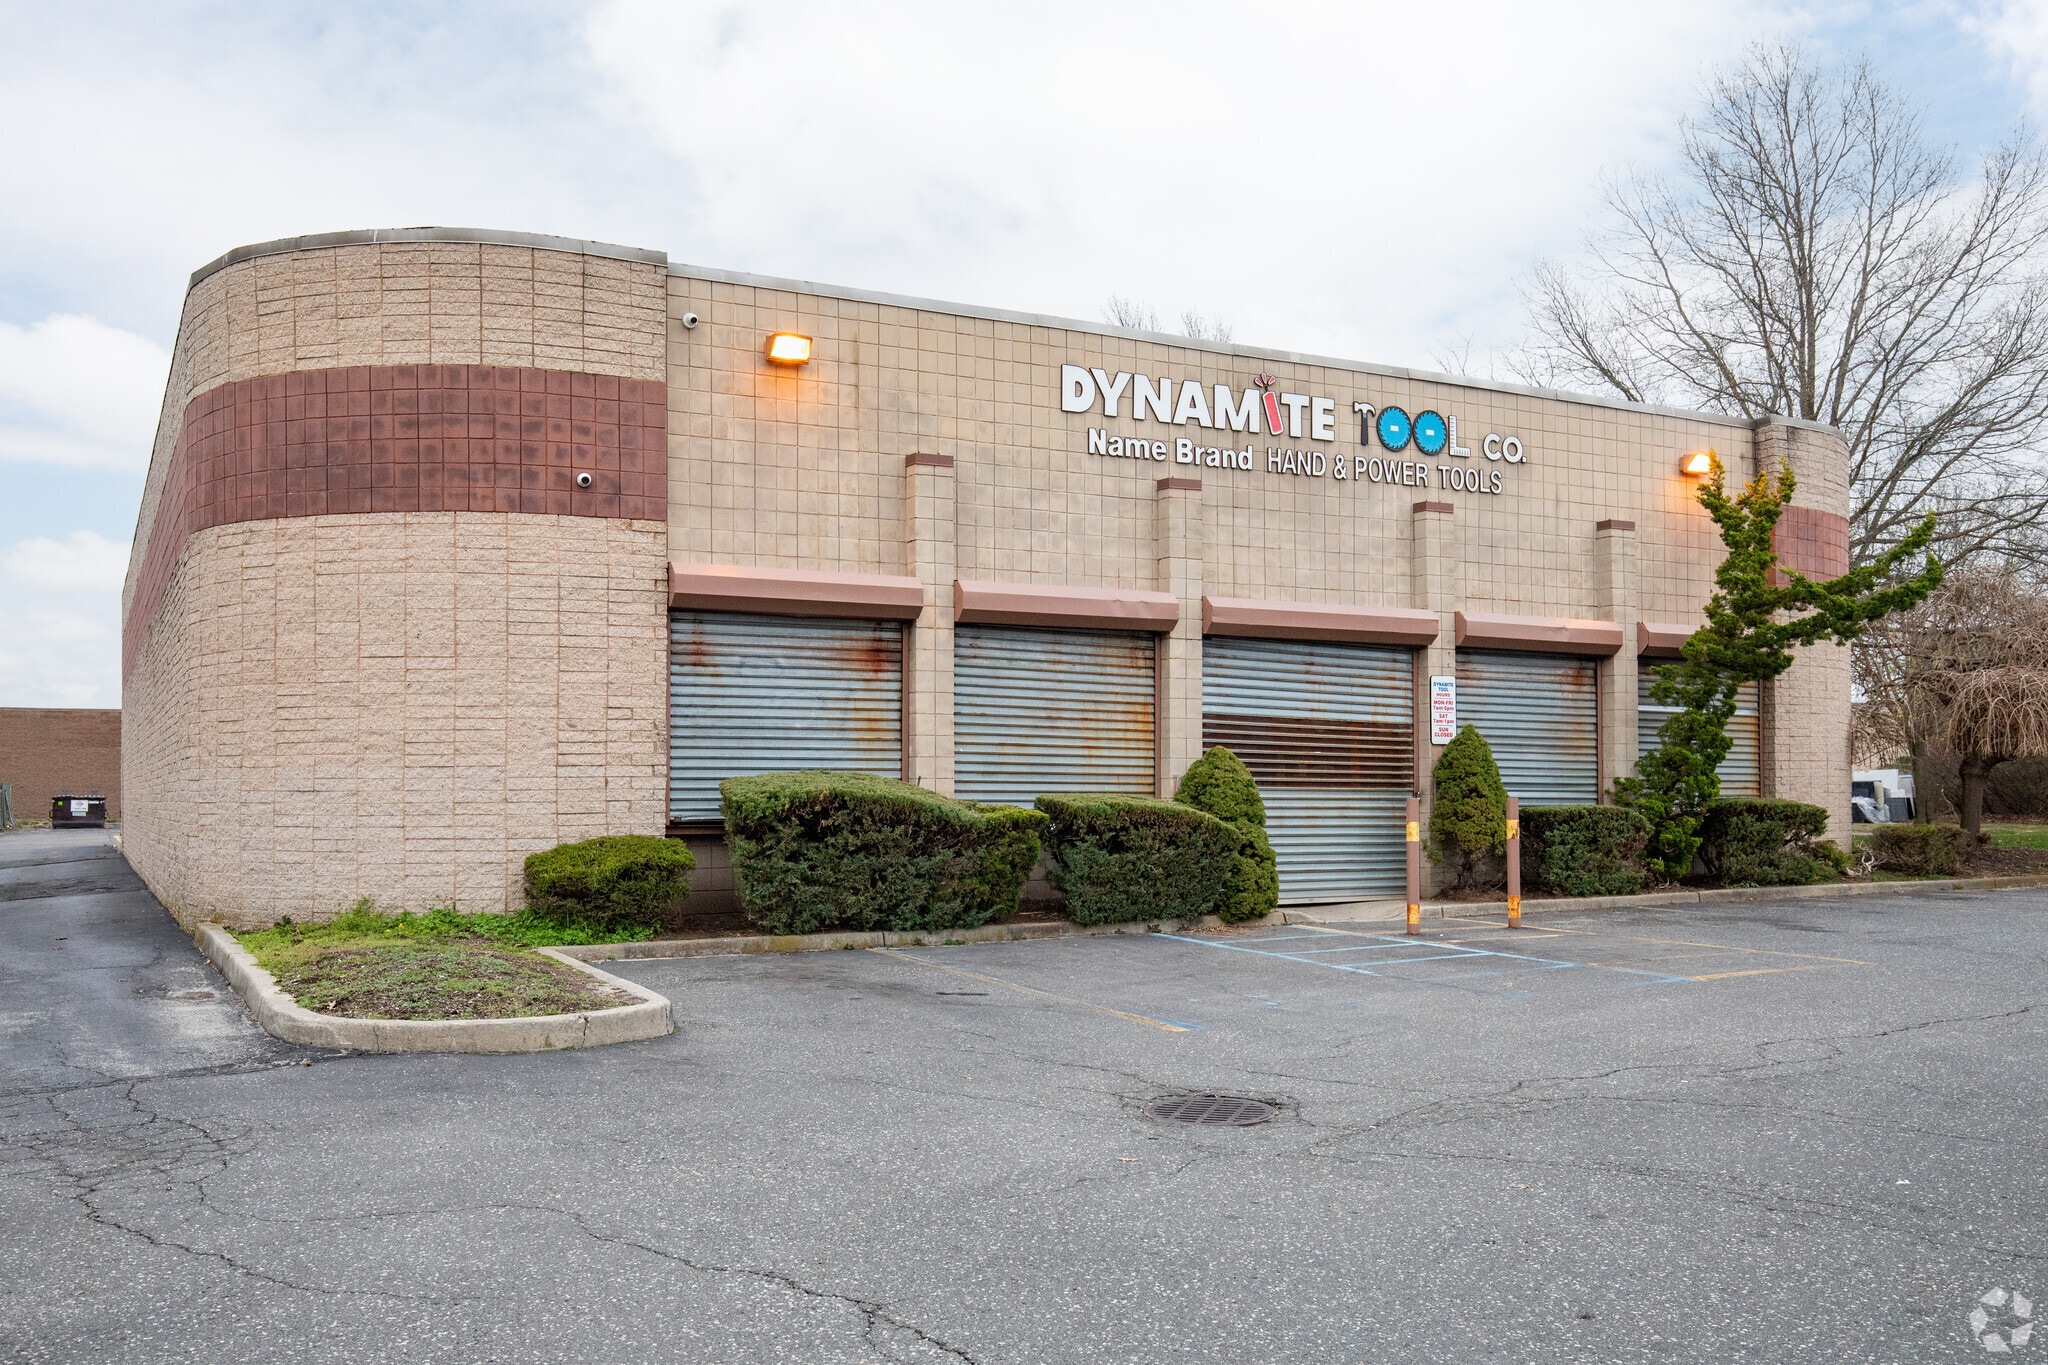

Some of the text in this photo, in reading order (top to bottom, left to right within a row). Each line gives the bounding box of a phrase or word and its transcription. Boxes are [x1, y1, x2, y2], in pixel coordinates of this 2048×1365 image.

[1061, 364, 1527, 464] DYNAMITE TOOL CO.
[1088, 427, 1503, 495] Name Brand HAND & POWER TOOLS
